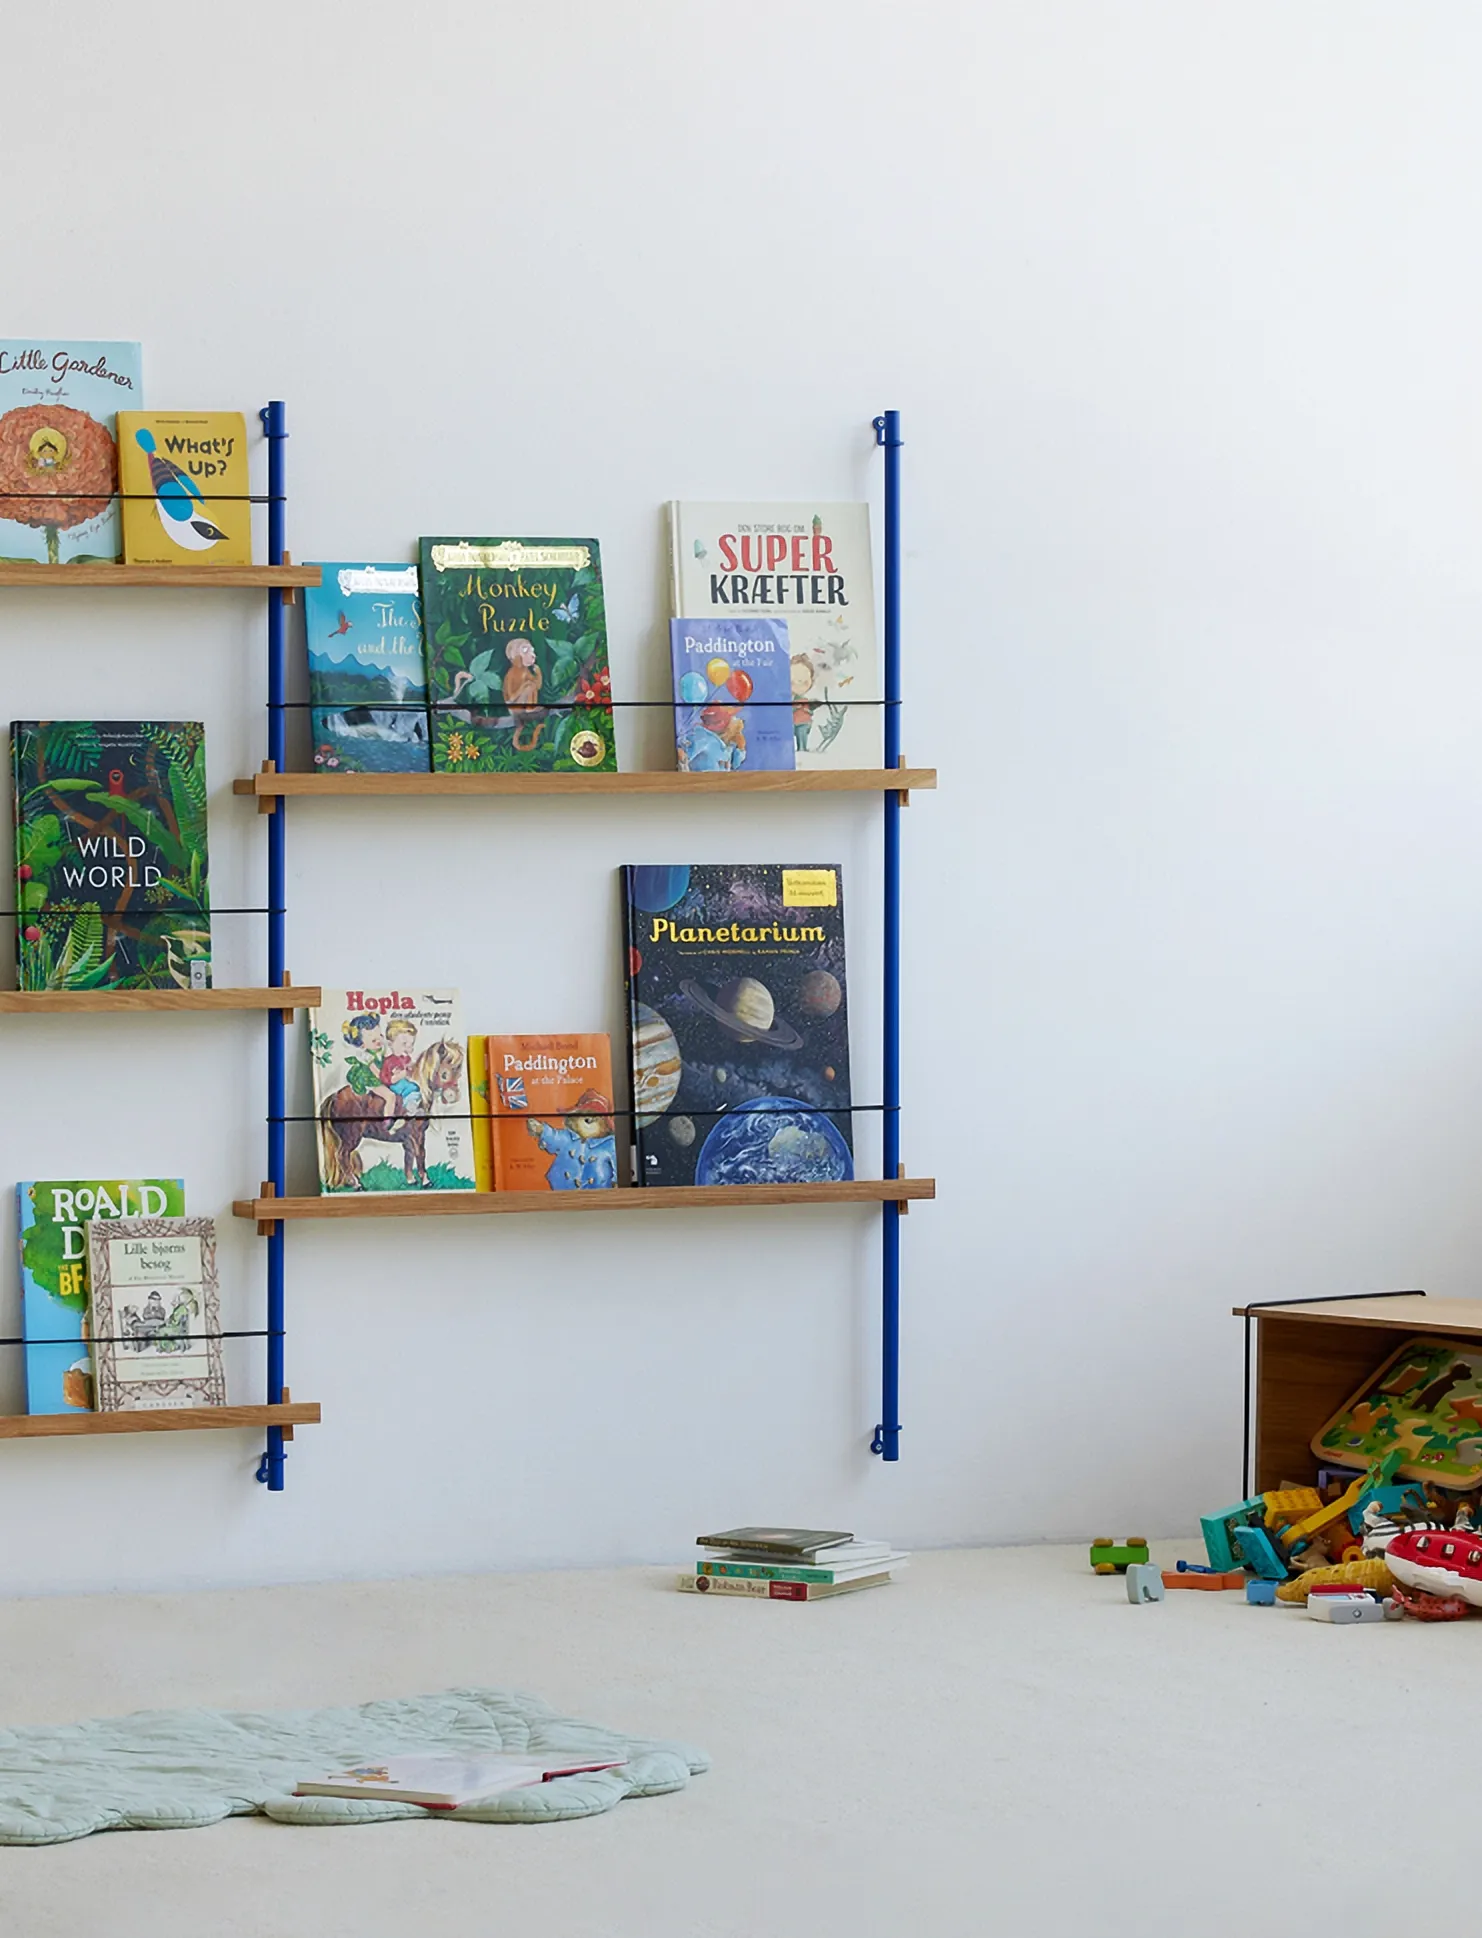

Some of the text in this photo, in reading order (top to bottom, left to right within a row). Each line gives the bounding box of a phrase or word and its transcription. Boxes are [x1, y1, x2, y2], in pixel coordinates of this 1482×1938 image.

[0, 350, 134, 391] Little Gardener
[718, 533, 839, 574] SUPER
[459, 574, 557, 608] Monkey
[710, 573, 849, 606] KRÆFTER
[371, 600, 408, 629] The
[478, 603, 550, 633] Puzzle
[357, 636, 385, 654] and
[391, 636, 415, 655] the
[684, 635, 776, 658] Paddington
[77, 836, 146, 858] WILD
[62, 866, 162, 888] WORLD
[649, 918, 826, 944] Planetarium
[346, 991, 416, 1015] Hopla
[503, 1054, 598, 1075] Paddington
[51, 1184, 168, 1222] ROALD
[124, 1243, 147, 1255] Lille
[59, 1263, 88, 1297] BF
